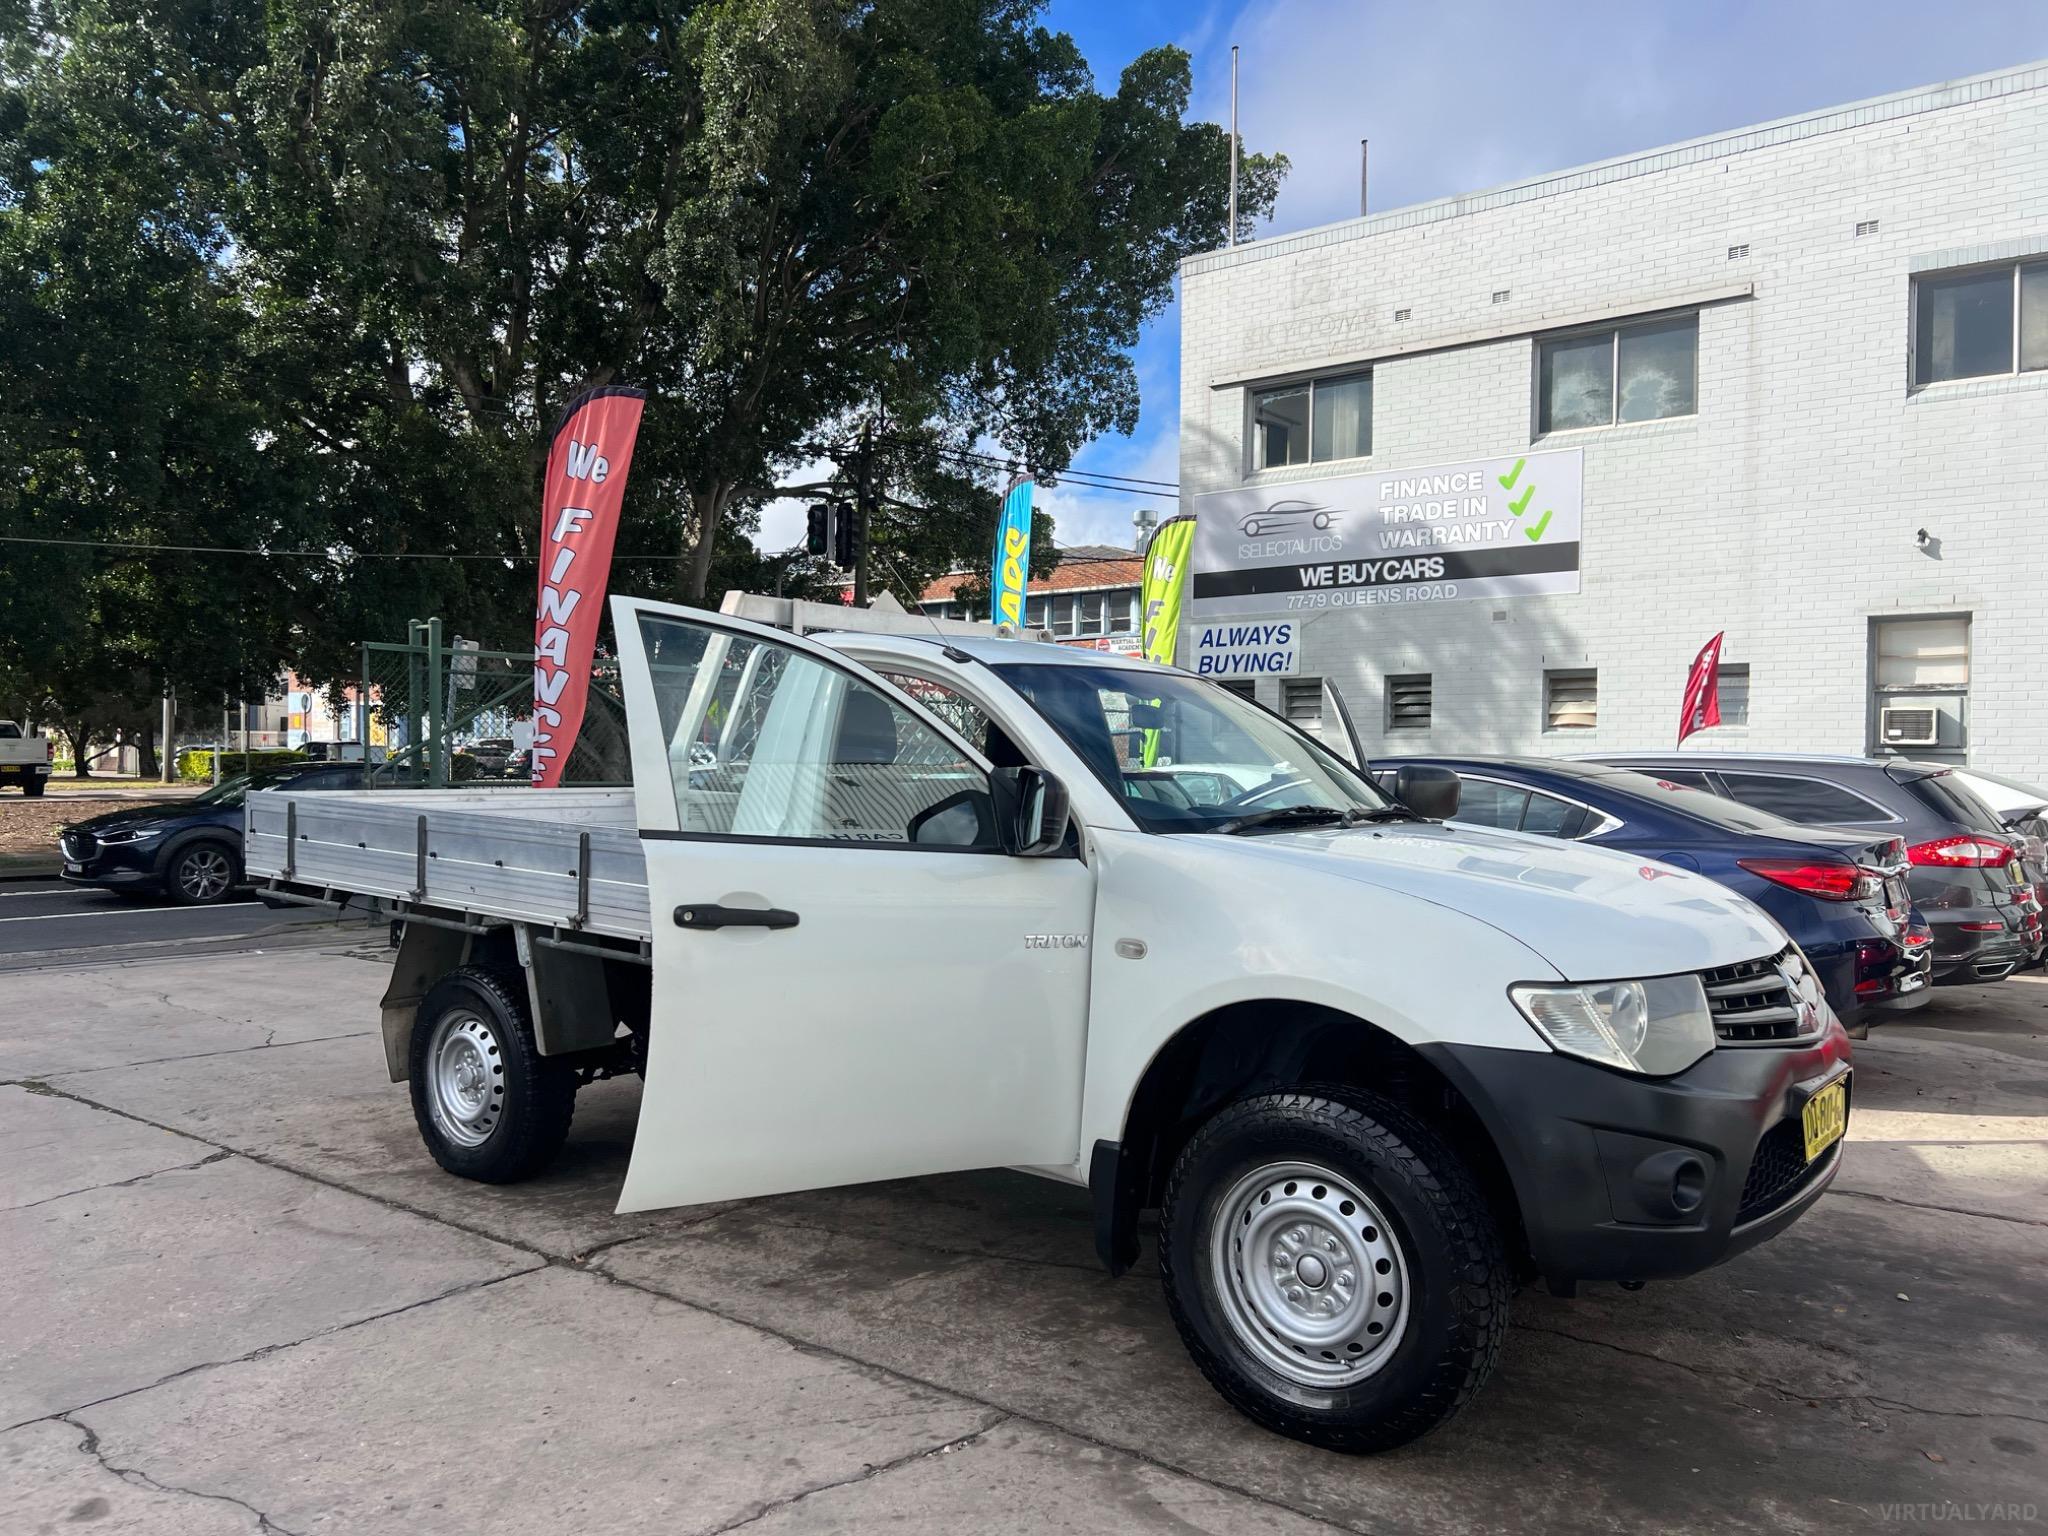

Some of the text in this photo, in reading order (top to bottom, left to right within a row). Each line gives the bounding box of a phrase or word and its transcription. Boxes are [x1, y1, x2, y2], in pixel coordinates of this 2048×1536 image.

[565, 439, 610, 484] We
[1378, 471, 1483, 500] FINANCE
[1379, 496, 1488, 524] TRADE IN
[1378, 519, 1515, 550] WARRANTY
[1152, 555, 1176, 584] We
[1299, 557, 1445, 587] WE BUY CARS
[1286, 584, 1459, 610] 77-79 QUEENS ROAD
[1198, 624, 1292, 649] ALWAYS
[1197, 651, 1293, 675] BUYING!
[1024, 934, 1089, 949] TRITON
